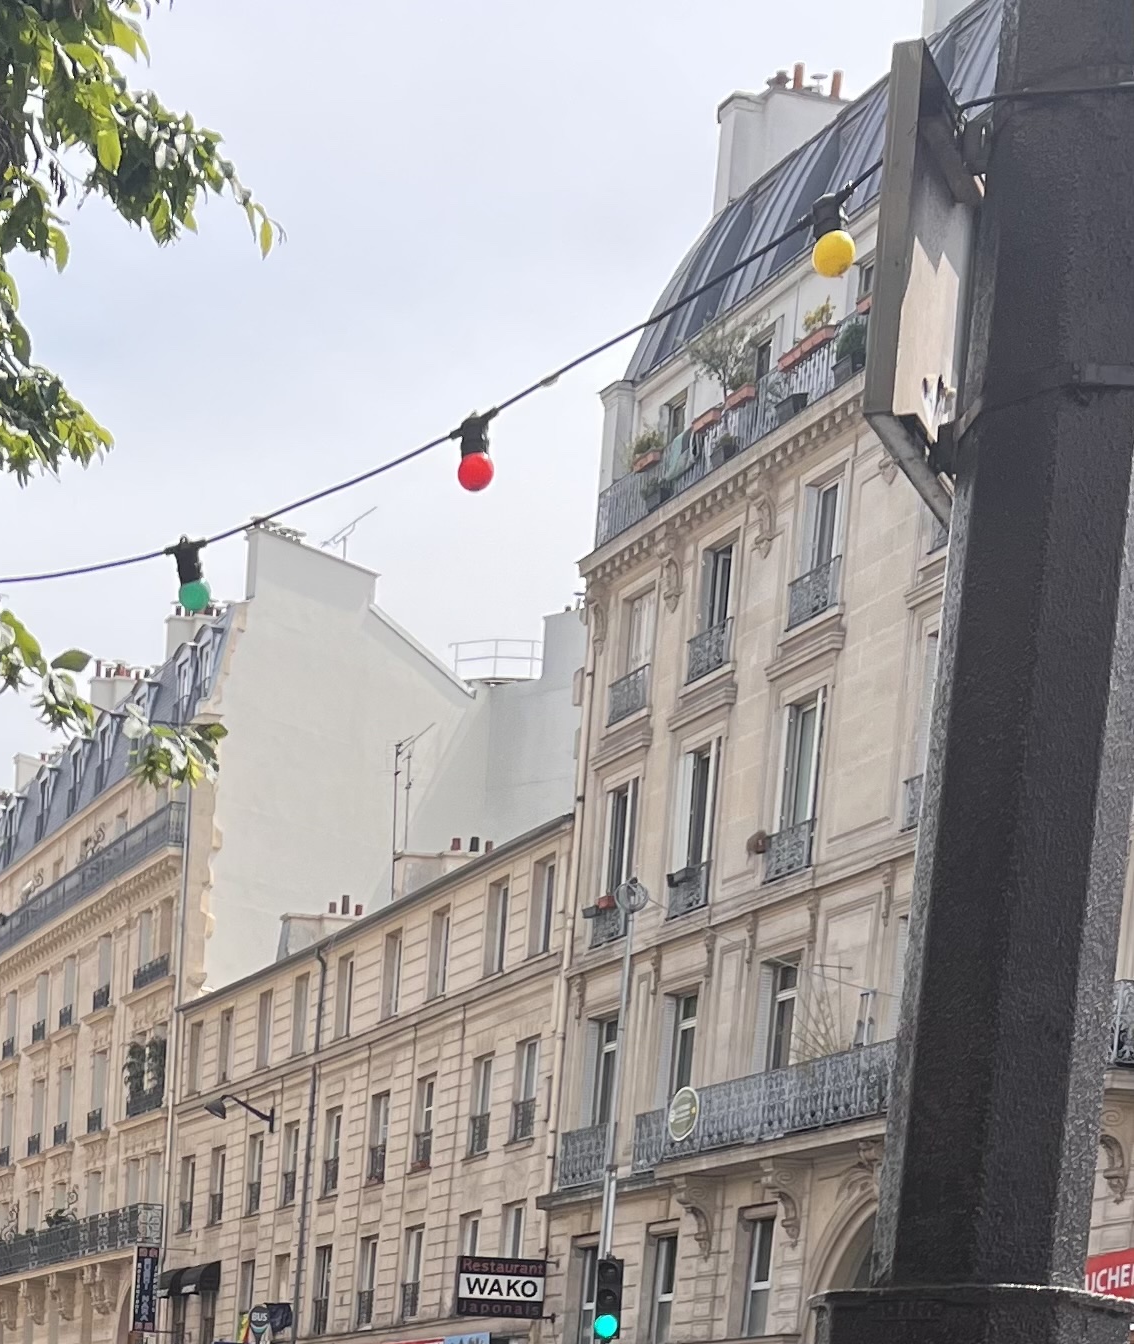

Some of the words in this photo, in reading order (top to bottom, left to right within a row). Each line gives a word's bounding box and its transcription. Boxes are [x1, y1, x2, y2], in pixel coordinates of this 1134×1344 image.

[462, 1258, 544, 1275] Restaurant
[465, 1277, 538, 1298] WAKO
[251, 1311, 268, 1321] BUS
[461, 1300, 540, 1316] Japonais
